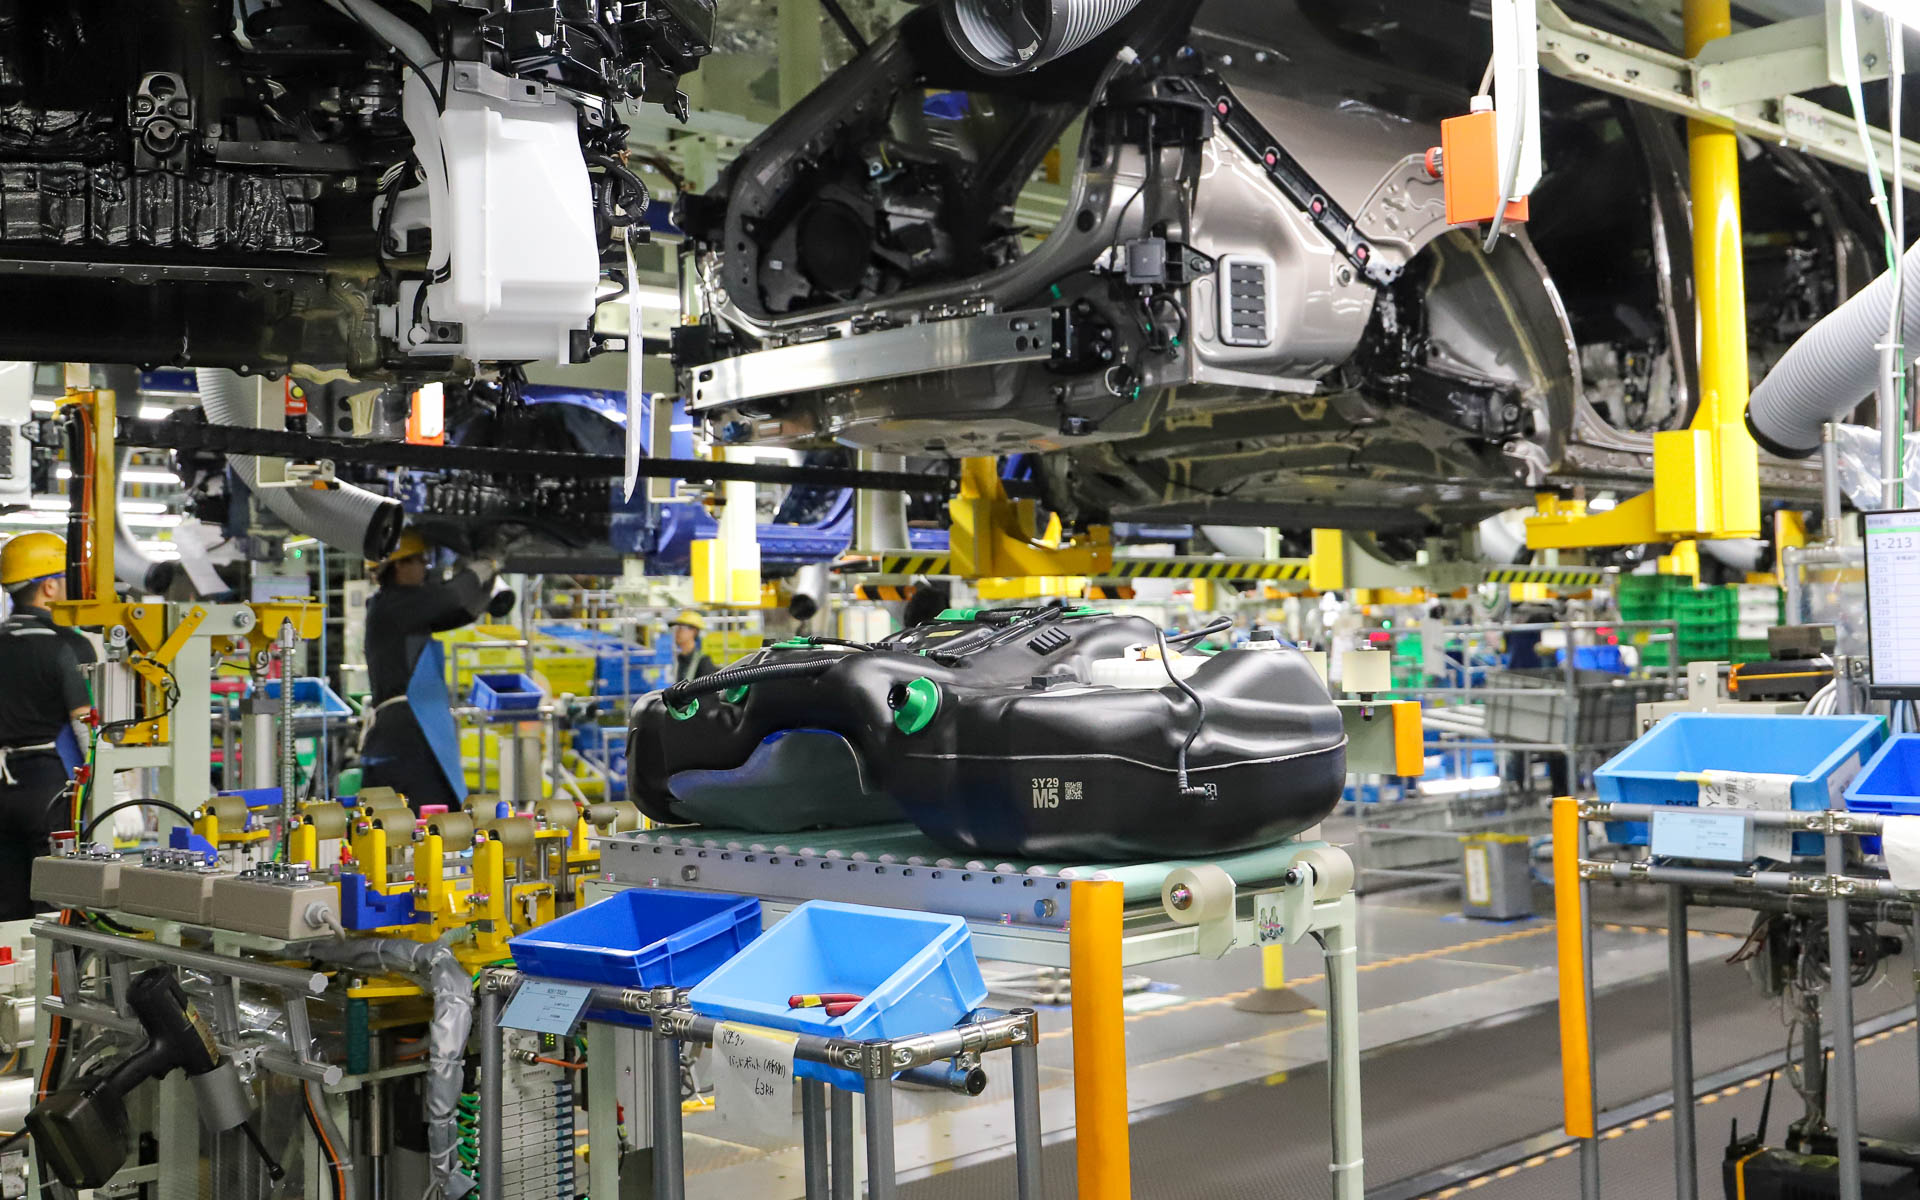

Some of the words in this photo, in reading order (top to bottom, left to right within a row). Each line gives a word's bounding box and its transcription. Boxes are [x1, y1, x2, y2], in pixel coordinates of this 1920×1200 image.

[1873, 536, 1912, 550] 1-213
[1032, 778, 1059, 788] 3Y29
[1033, 788, 1059, 808] M5
